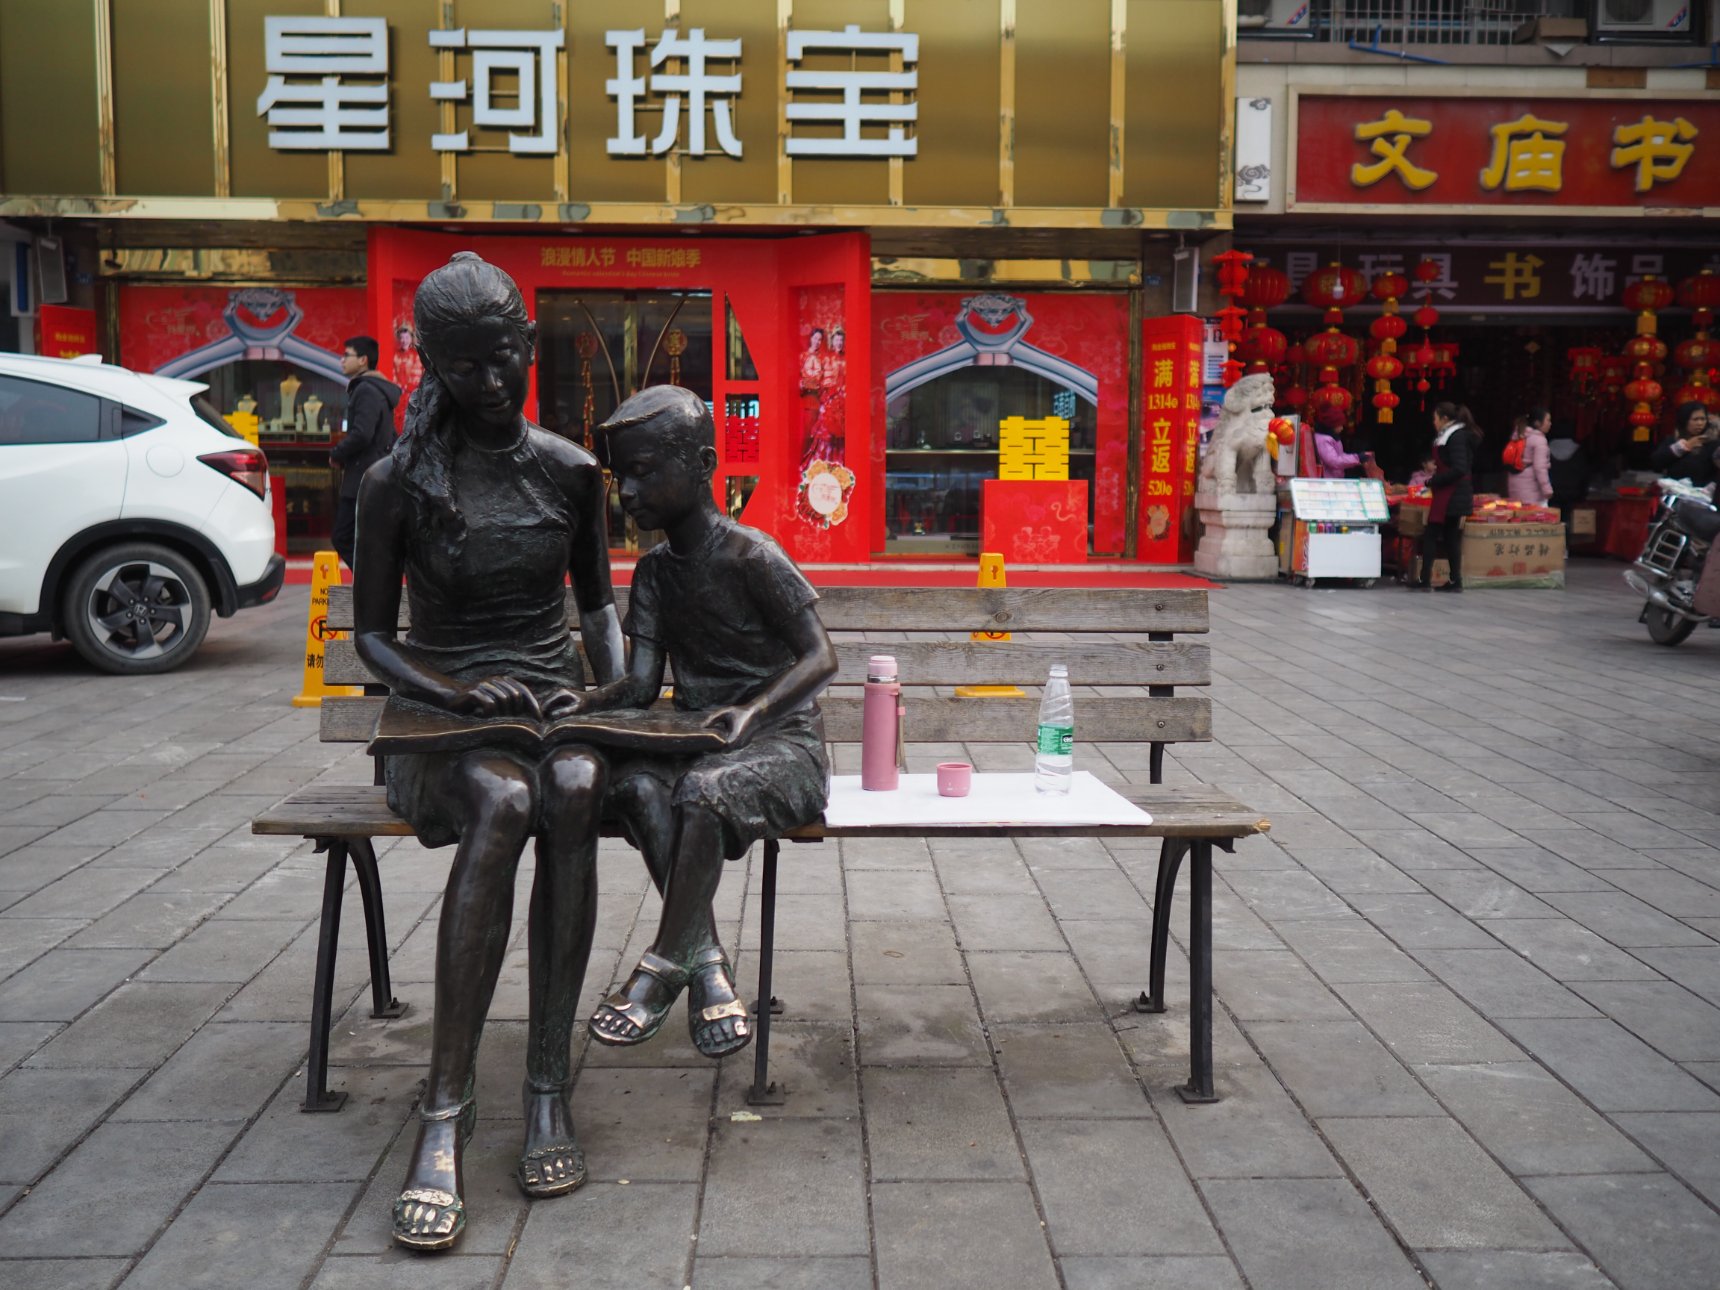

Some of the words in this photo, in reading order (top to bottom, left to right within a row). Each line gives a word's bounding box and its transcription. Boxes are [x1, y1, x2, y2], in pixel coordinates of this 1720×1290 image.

[257, 15, 919, 158] 星河珠宝
[1351, 109, 1699, 192] 文庙书
[541, 246, 616, 267] 浪漫情人节
[626, 247, 701, 268] 中国新娘季
[1483, 251, 1545, 300] 书
[307, 653, 324, 668] 请勿
